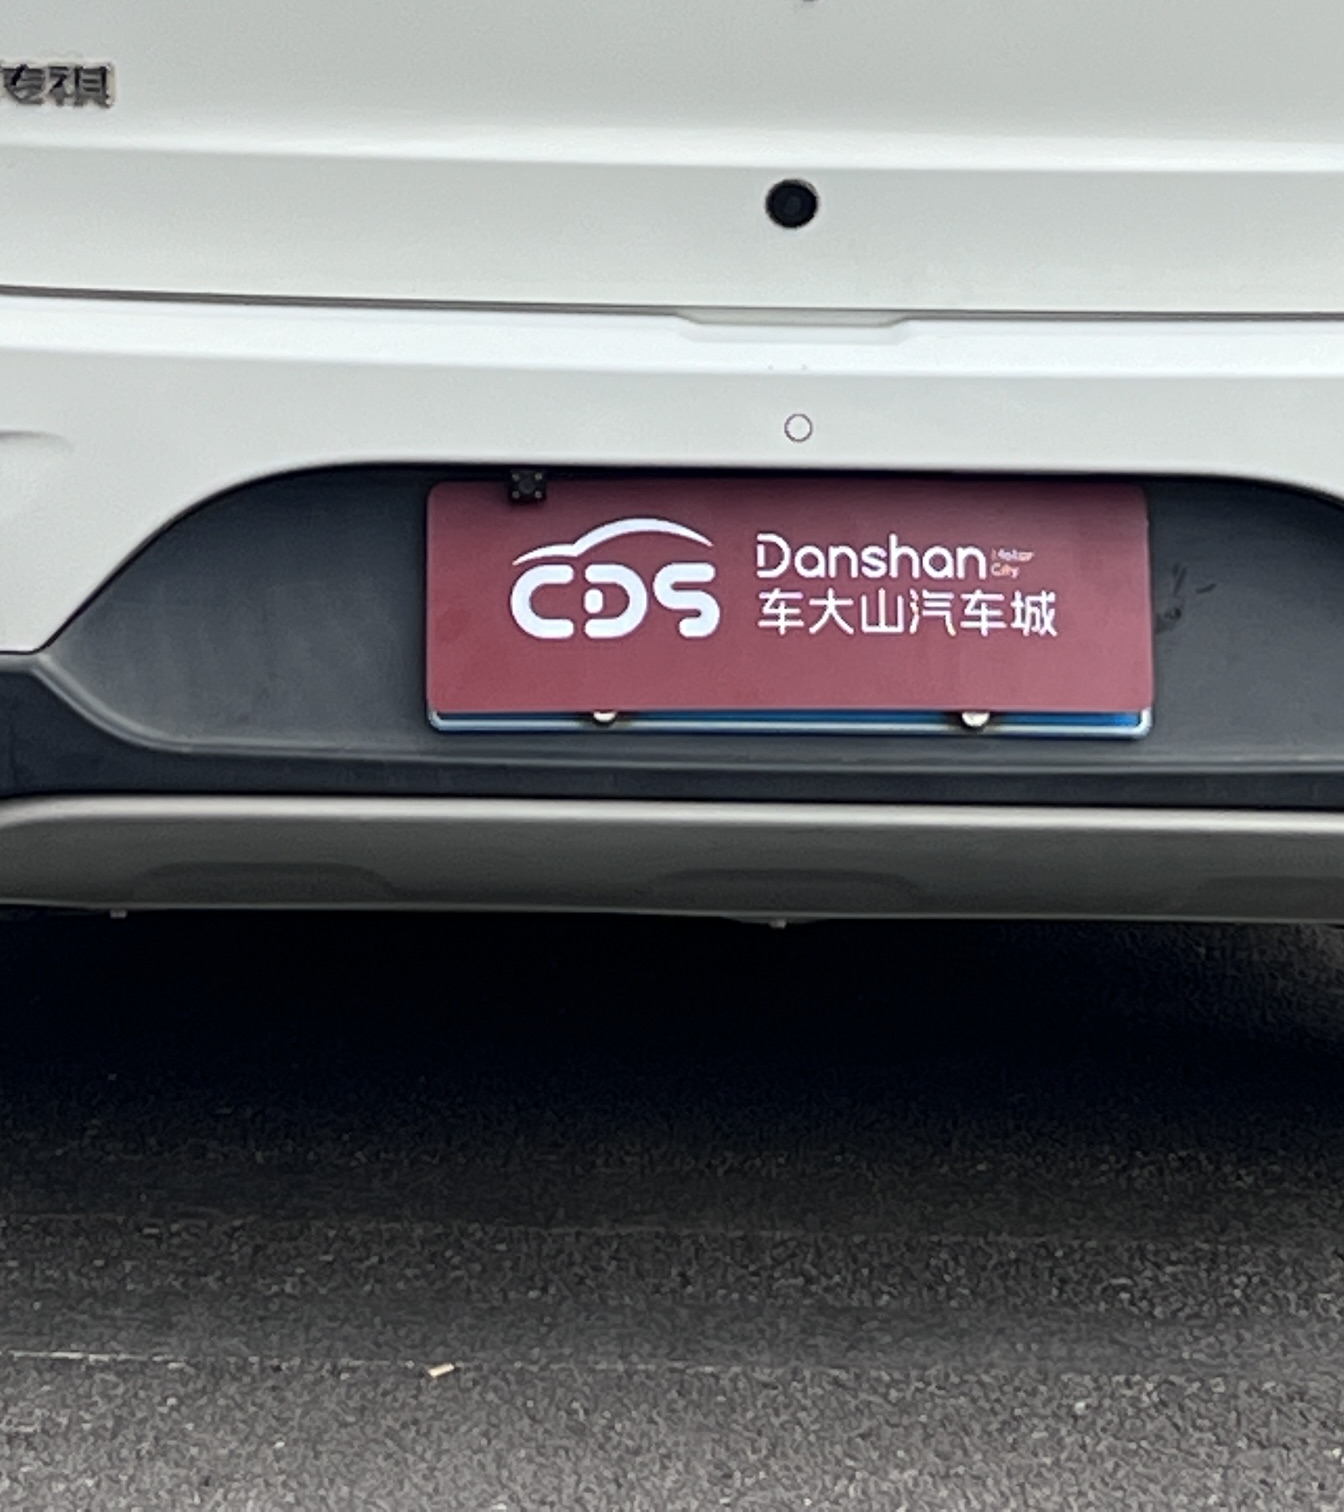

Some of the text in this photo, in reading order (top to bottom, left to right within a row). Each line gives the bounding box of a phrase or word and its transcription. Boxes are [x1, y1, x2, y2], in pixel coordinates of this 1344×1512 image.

[756, 532, 988, 580] Danshan
[509, 562, 721, 639] CDS
[757, 587, 1058, 637] 车大山汽车城
